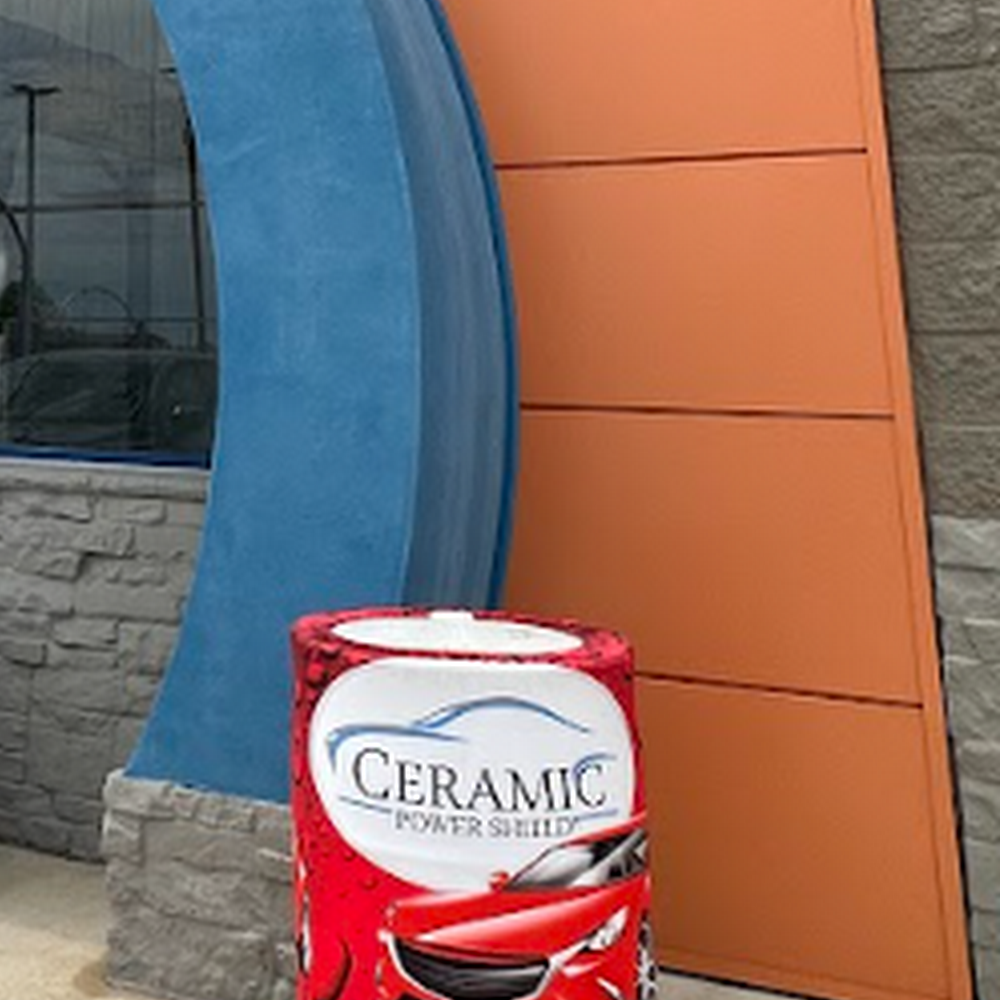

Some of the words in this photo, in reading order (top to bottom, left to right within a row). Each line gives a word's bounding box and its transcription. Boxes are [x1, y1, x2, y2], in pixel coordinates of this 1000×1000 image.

[351, 746, 607, 813] CERAMIC
[394, 809, 483, 838] POWER
[487, 814, 576, 838] SHIELD
